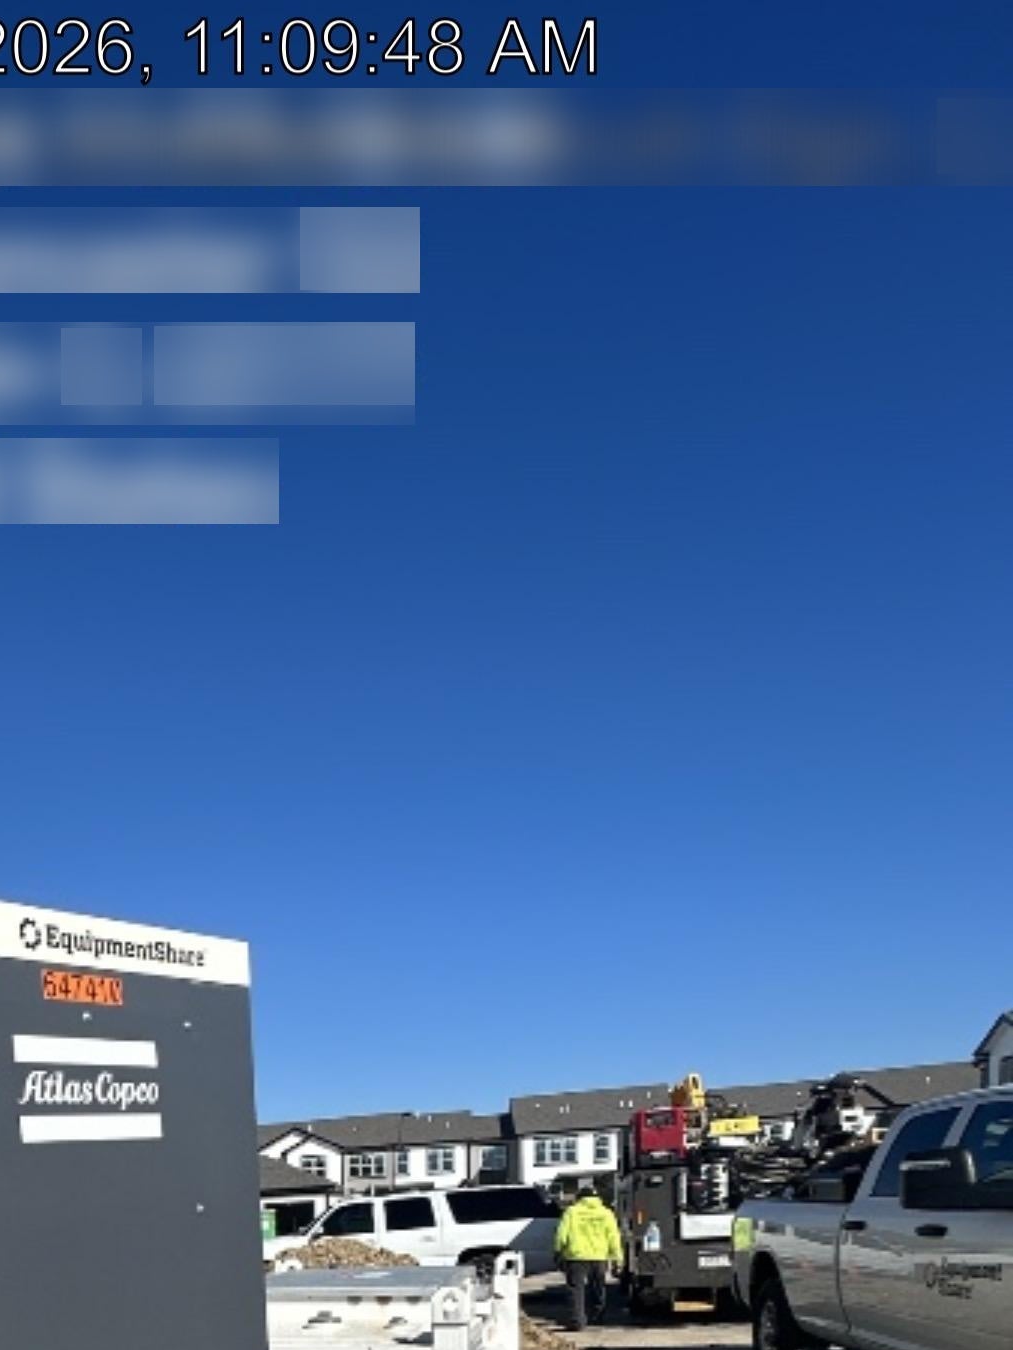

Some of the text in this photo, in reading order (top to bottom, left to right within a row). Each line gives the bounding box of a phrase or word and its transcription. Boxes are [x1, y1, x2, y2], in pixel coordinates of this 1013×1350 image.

[45, 923, 205, 967] EquipmentShare
[19, 1069, 159, 1111] Atlas Copco
